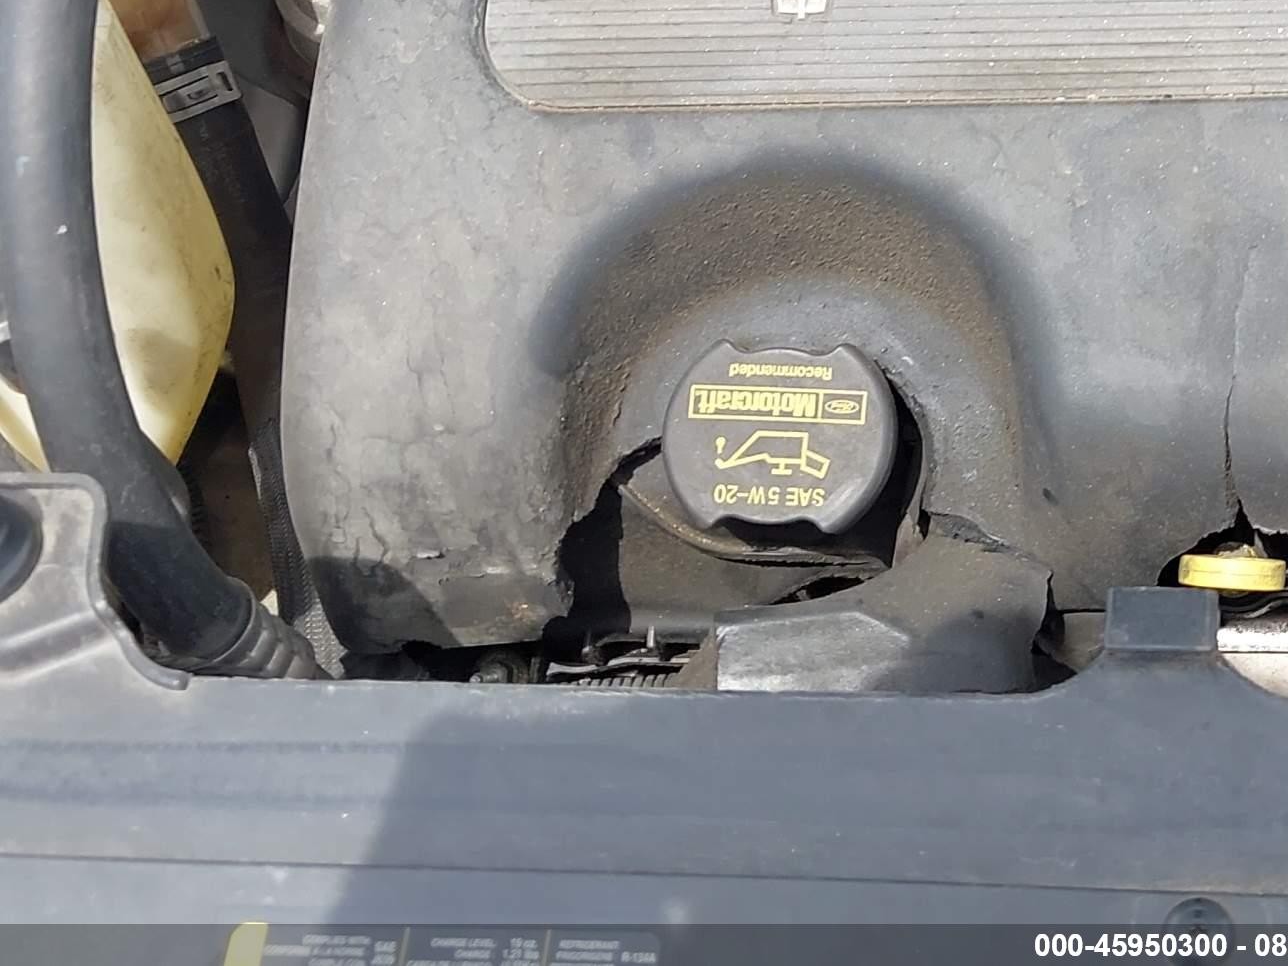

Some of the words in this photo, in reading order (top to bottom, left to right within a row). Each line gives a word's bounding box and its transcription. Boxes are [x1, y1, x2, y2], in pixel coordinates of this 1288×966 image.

[728, 362, 833, 381] Recommended
[695, 389, 817, 418] Motorcraft
[713, 484, 781, 505] 5W-20
[785, 486, 826, 507] SAE
